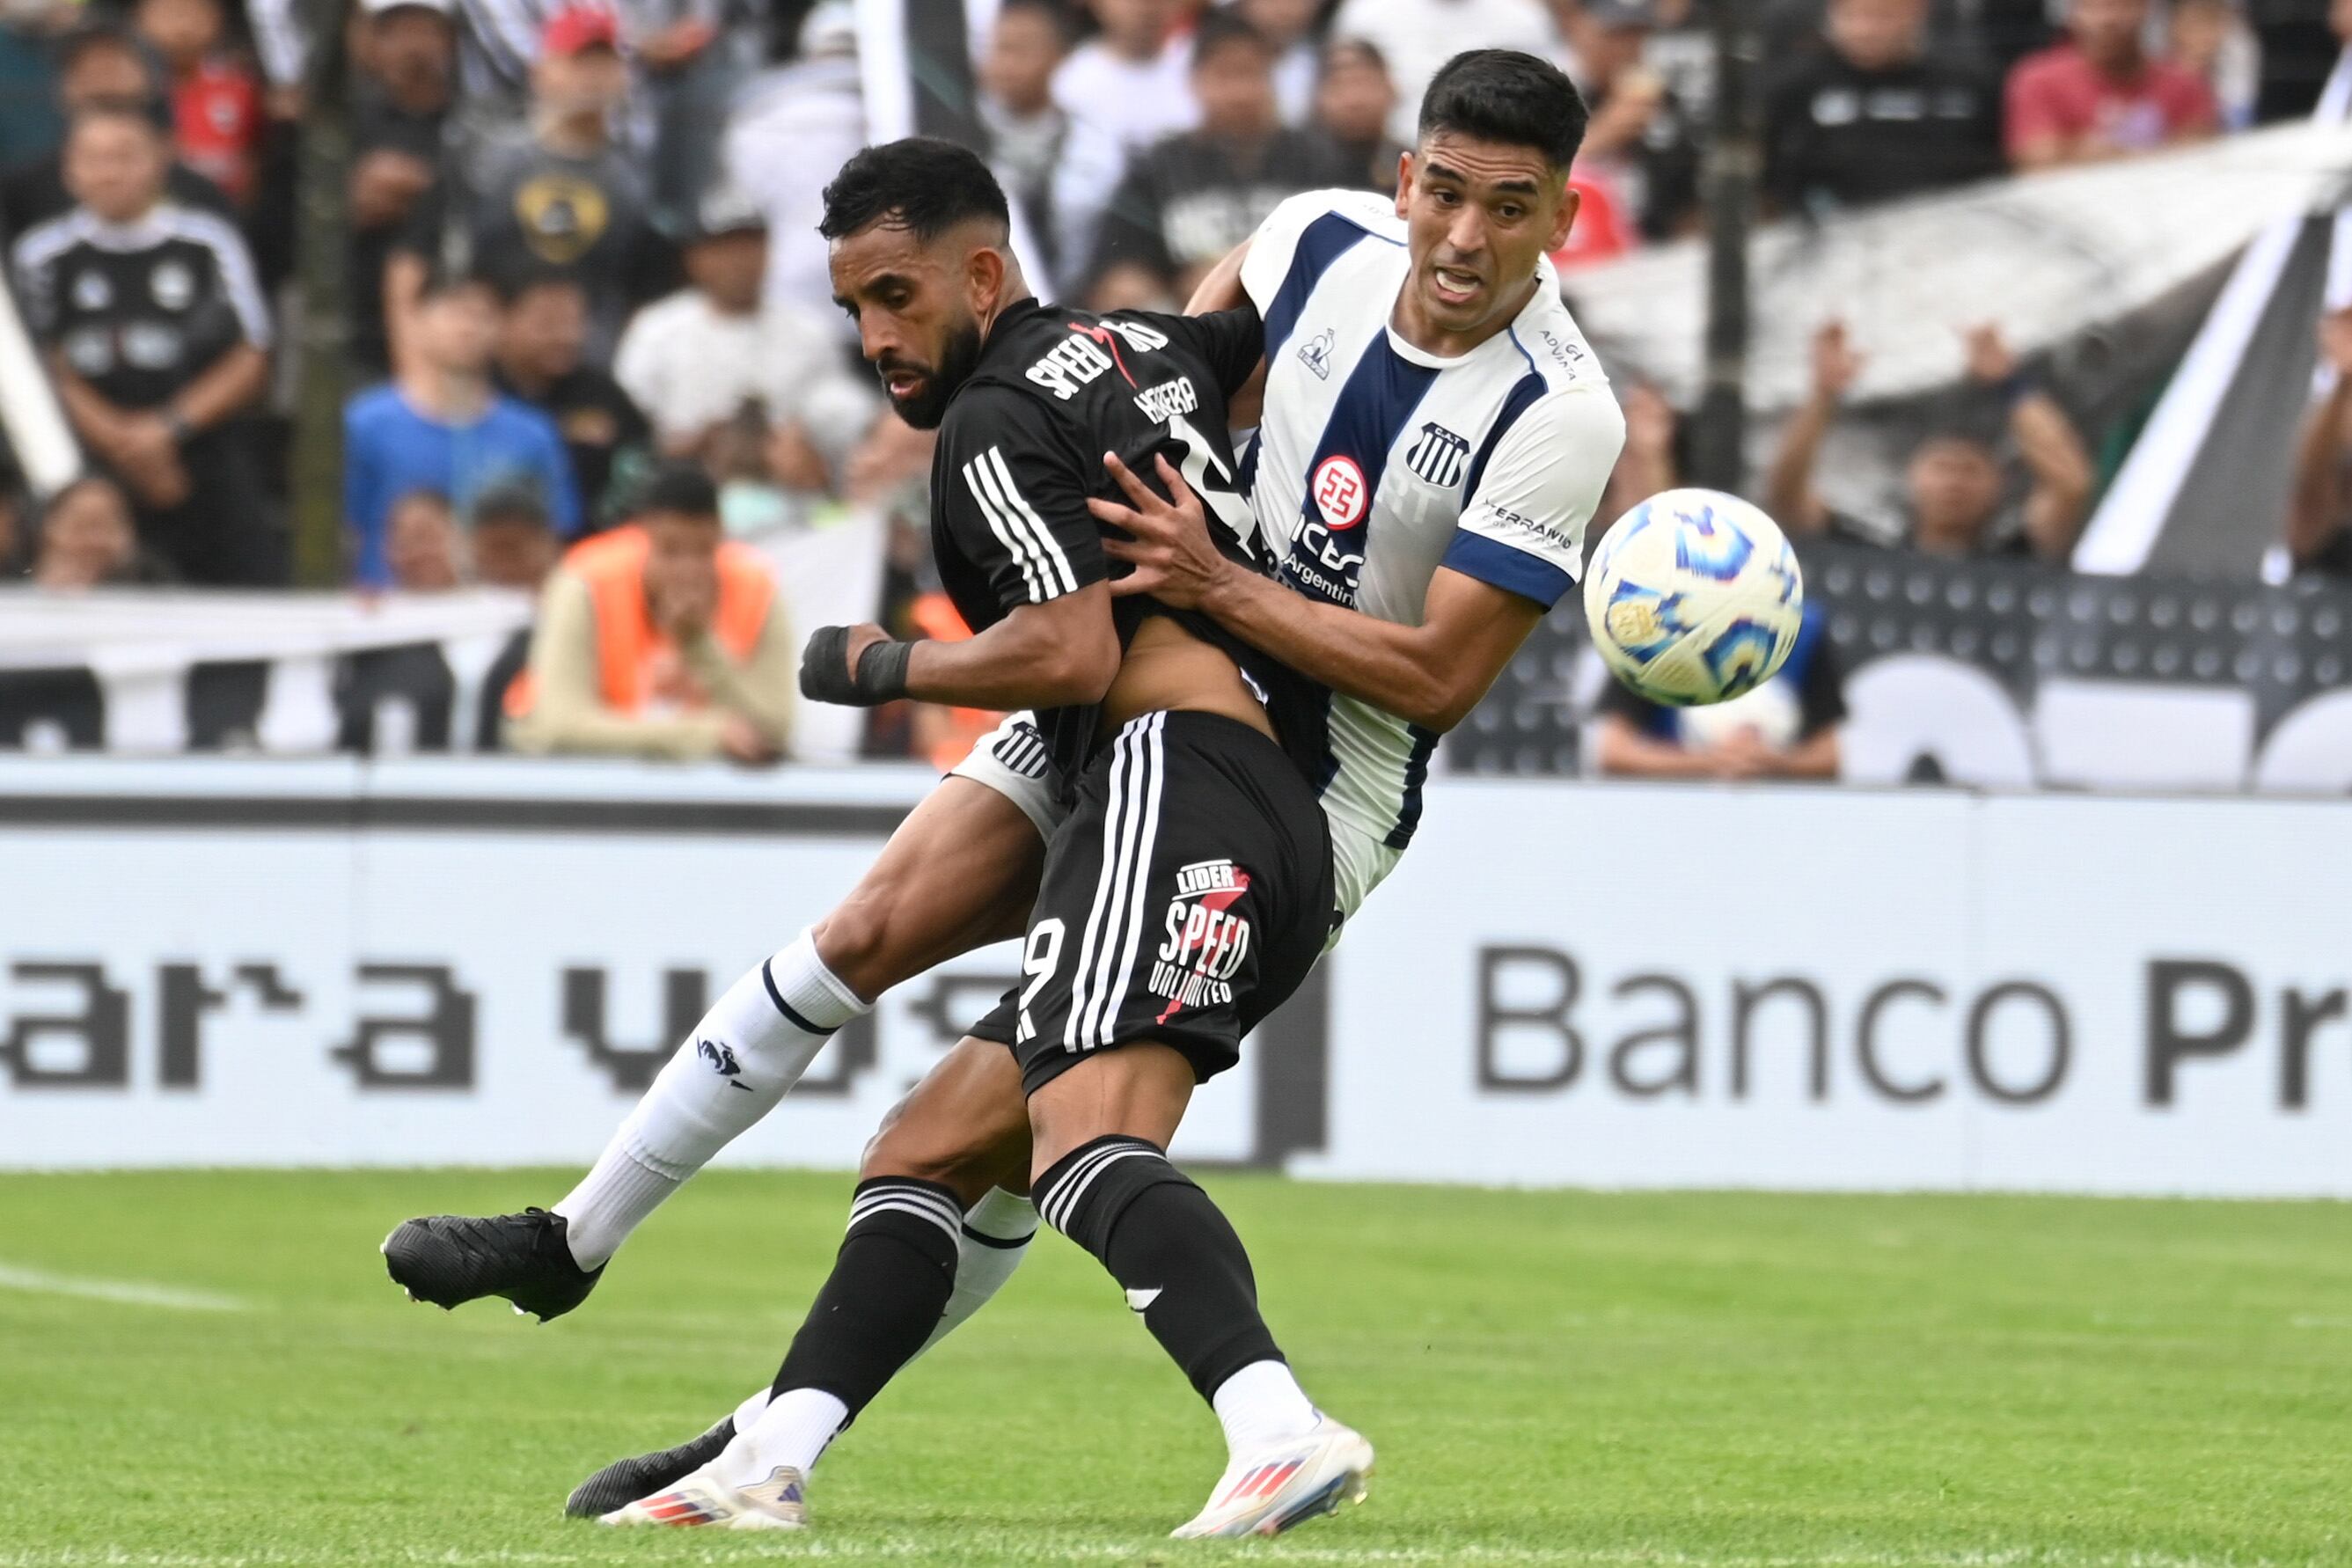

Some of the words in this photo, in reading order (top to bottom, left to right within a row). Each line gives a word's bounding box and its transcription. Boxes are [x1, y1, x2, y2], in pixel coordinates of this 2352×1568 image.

[1025, 333, 1113, 400] SPEED
[1176, 864, 1235, 894] LIDER
[1158, 900, 1251, 981] SPEED
[1147, 959, 1233, 1009] UNLIMITED
[1473, 944, 2073, 1107] Banco
[2143, 957, 2349, 1110] Pr
